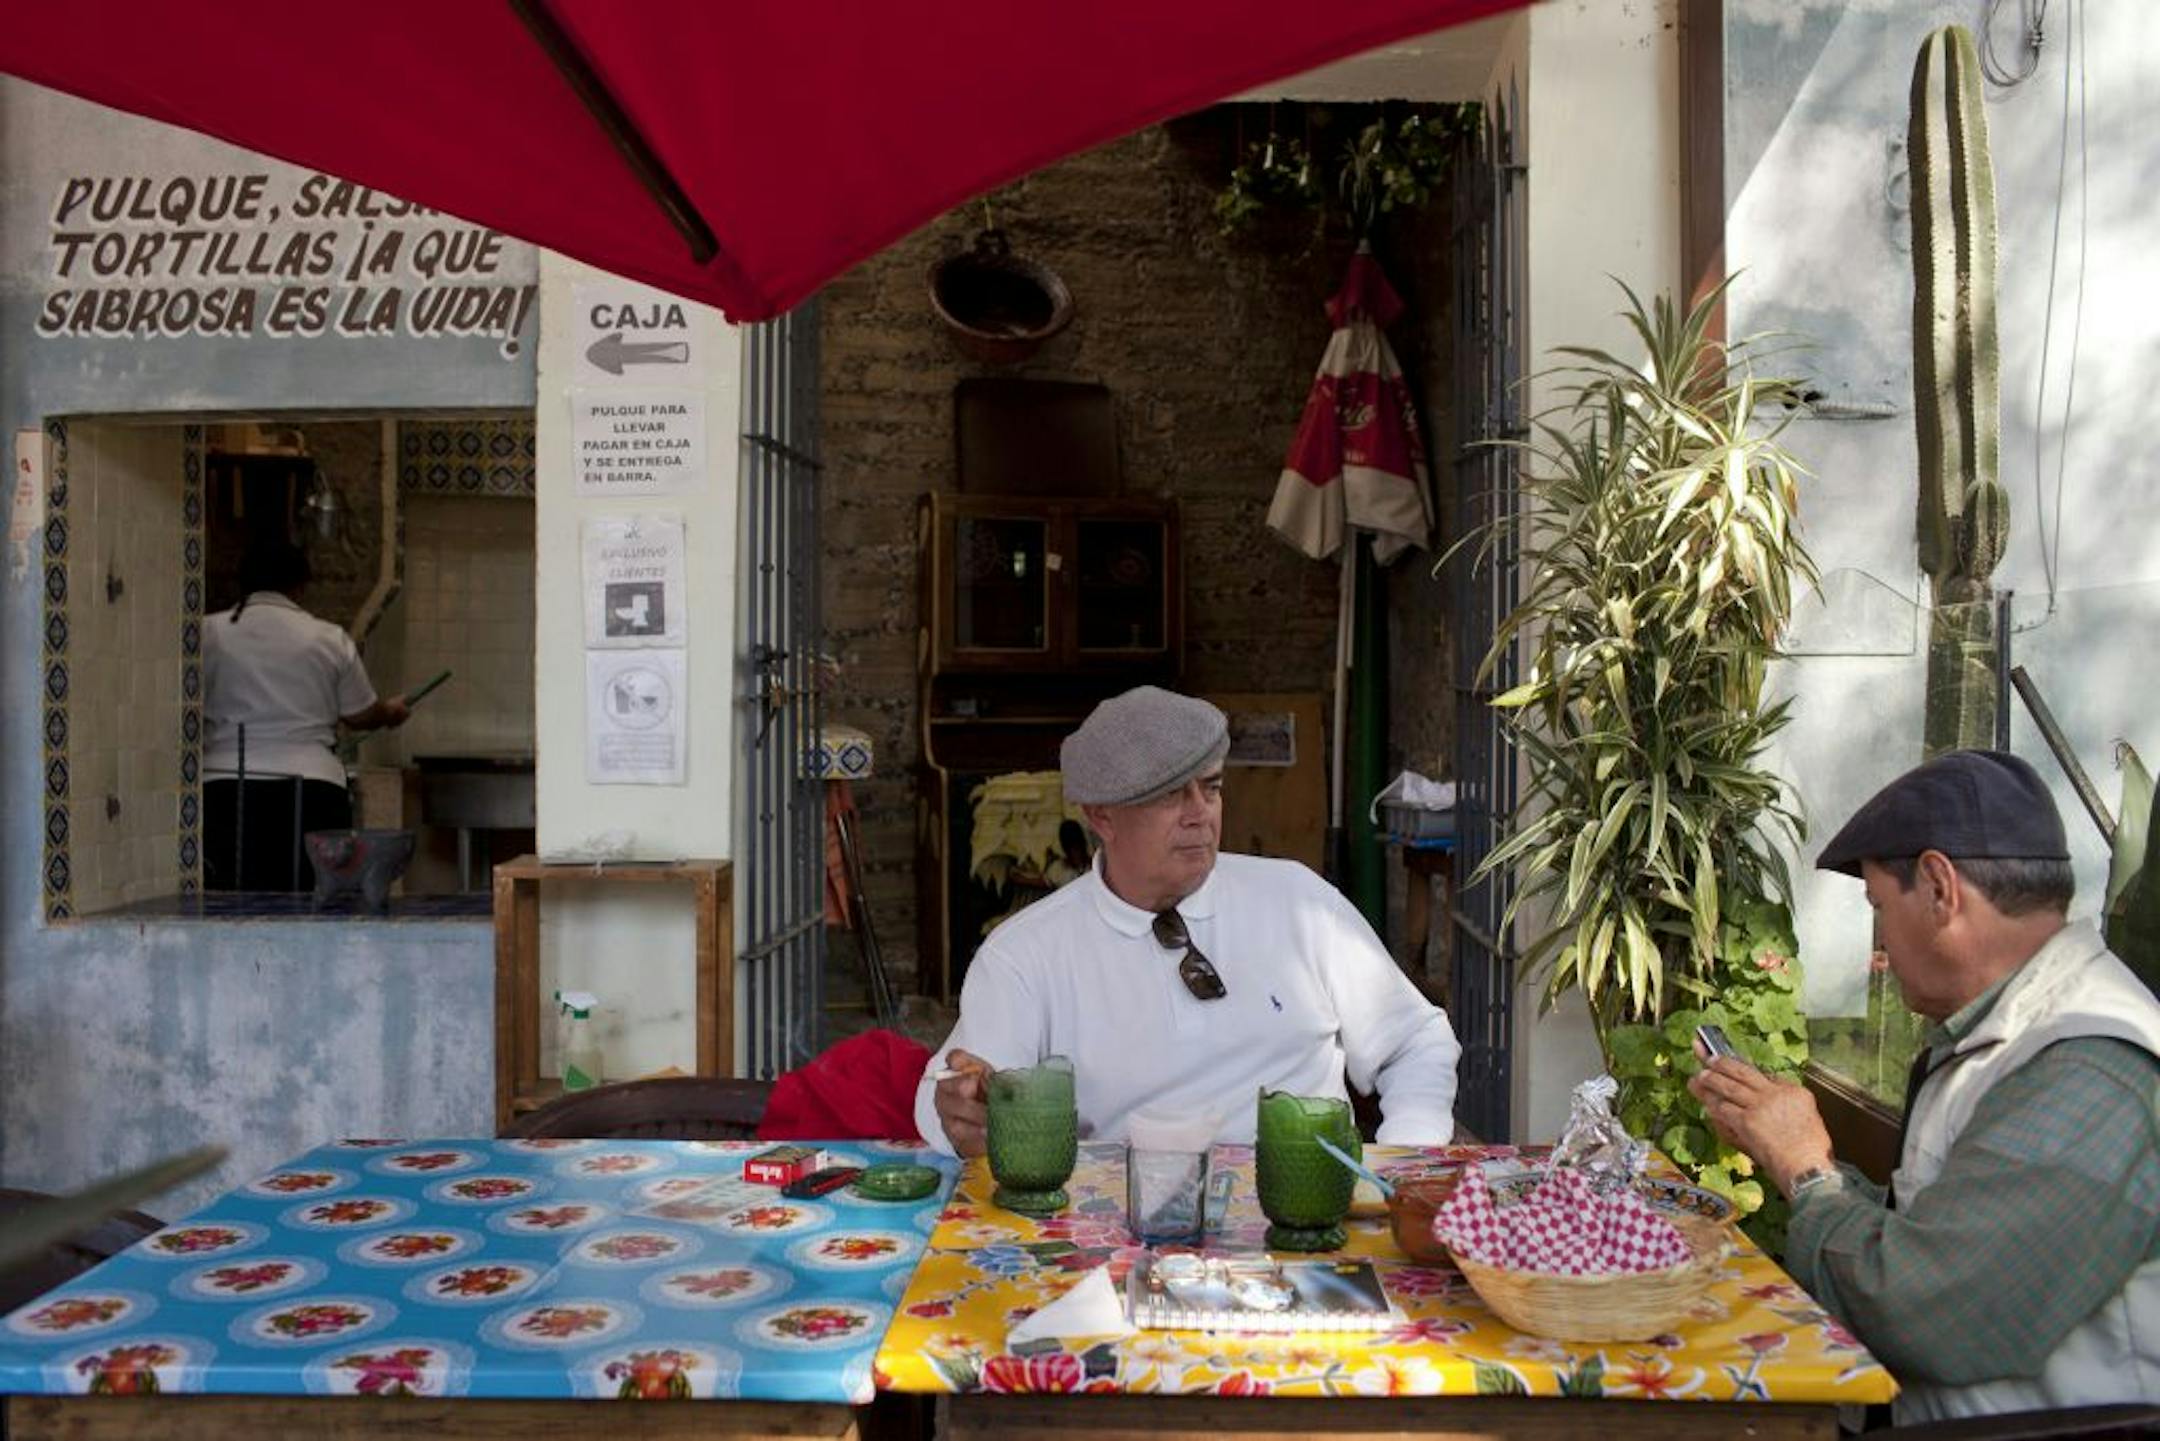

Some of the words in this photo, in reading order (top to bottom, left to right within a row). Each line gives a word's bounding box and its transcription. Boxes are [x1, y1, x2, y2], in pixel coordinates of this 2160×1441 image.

[53, 176, 279, 225] PULQUE,
[52, 231, 335, 278] TORTILLAS
[413, 230, 503, 276] QUE
[37, 287, 254, 334] SABROSA
[267, 286, 330, 333] ES
[341, 287, 402, 333] LA
[410, 284, 538, 355] VIDA!
[590, 304, 688, 329] CAJA
[591, 405, 646, 416] PULQUE
[651, 405, 687, 415] PARA
[613, 423, 665, 433] LLEVAR
[583, 440, 628, 450] PAGAR
[632, 440, 651, 449] EN
[655, 438, 690, 449] CAJA
[584, 458, 592, 467] Y
[597, 458, 612, 467] SE
[618, 456, 682, 467] ENTREGA
[584, 473, 602, 483] EN
